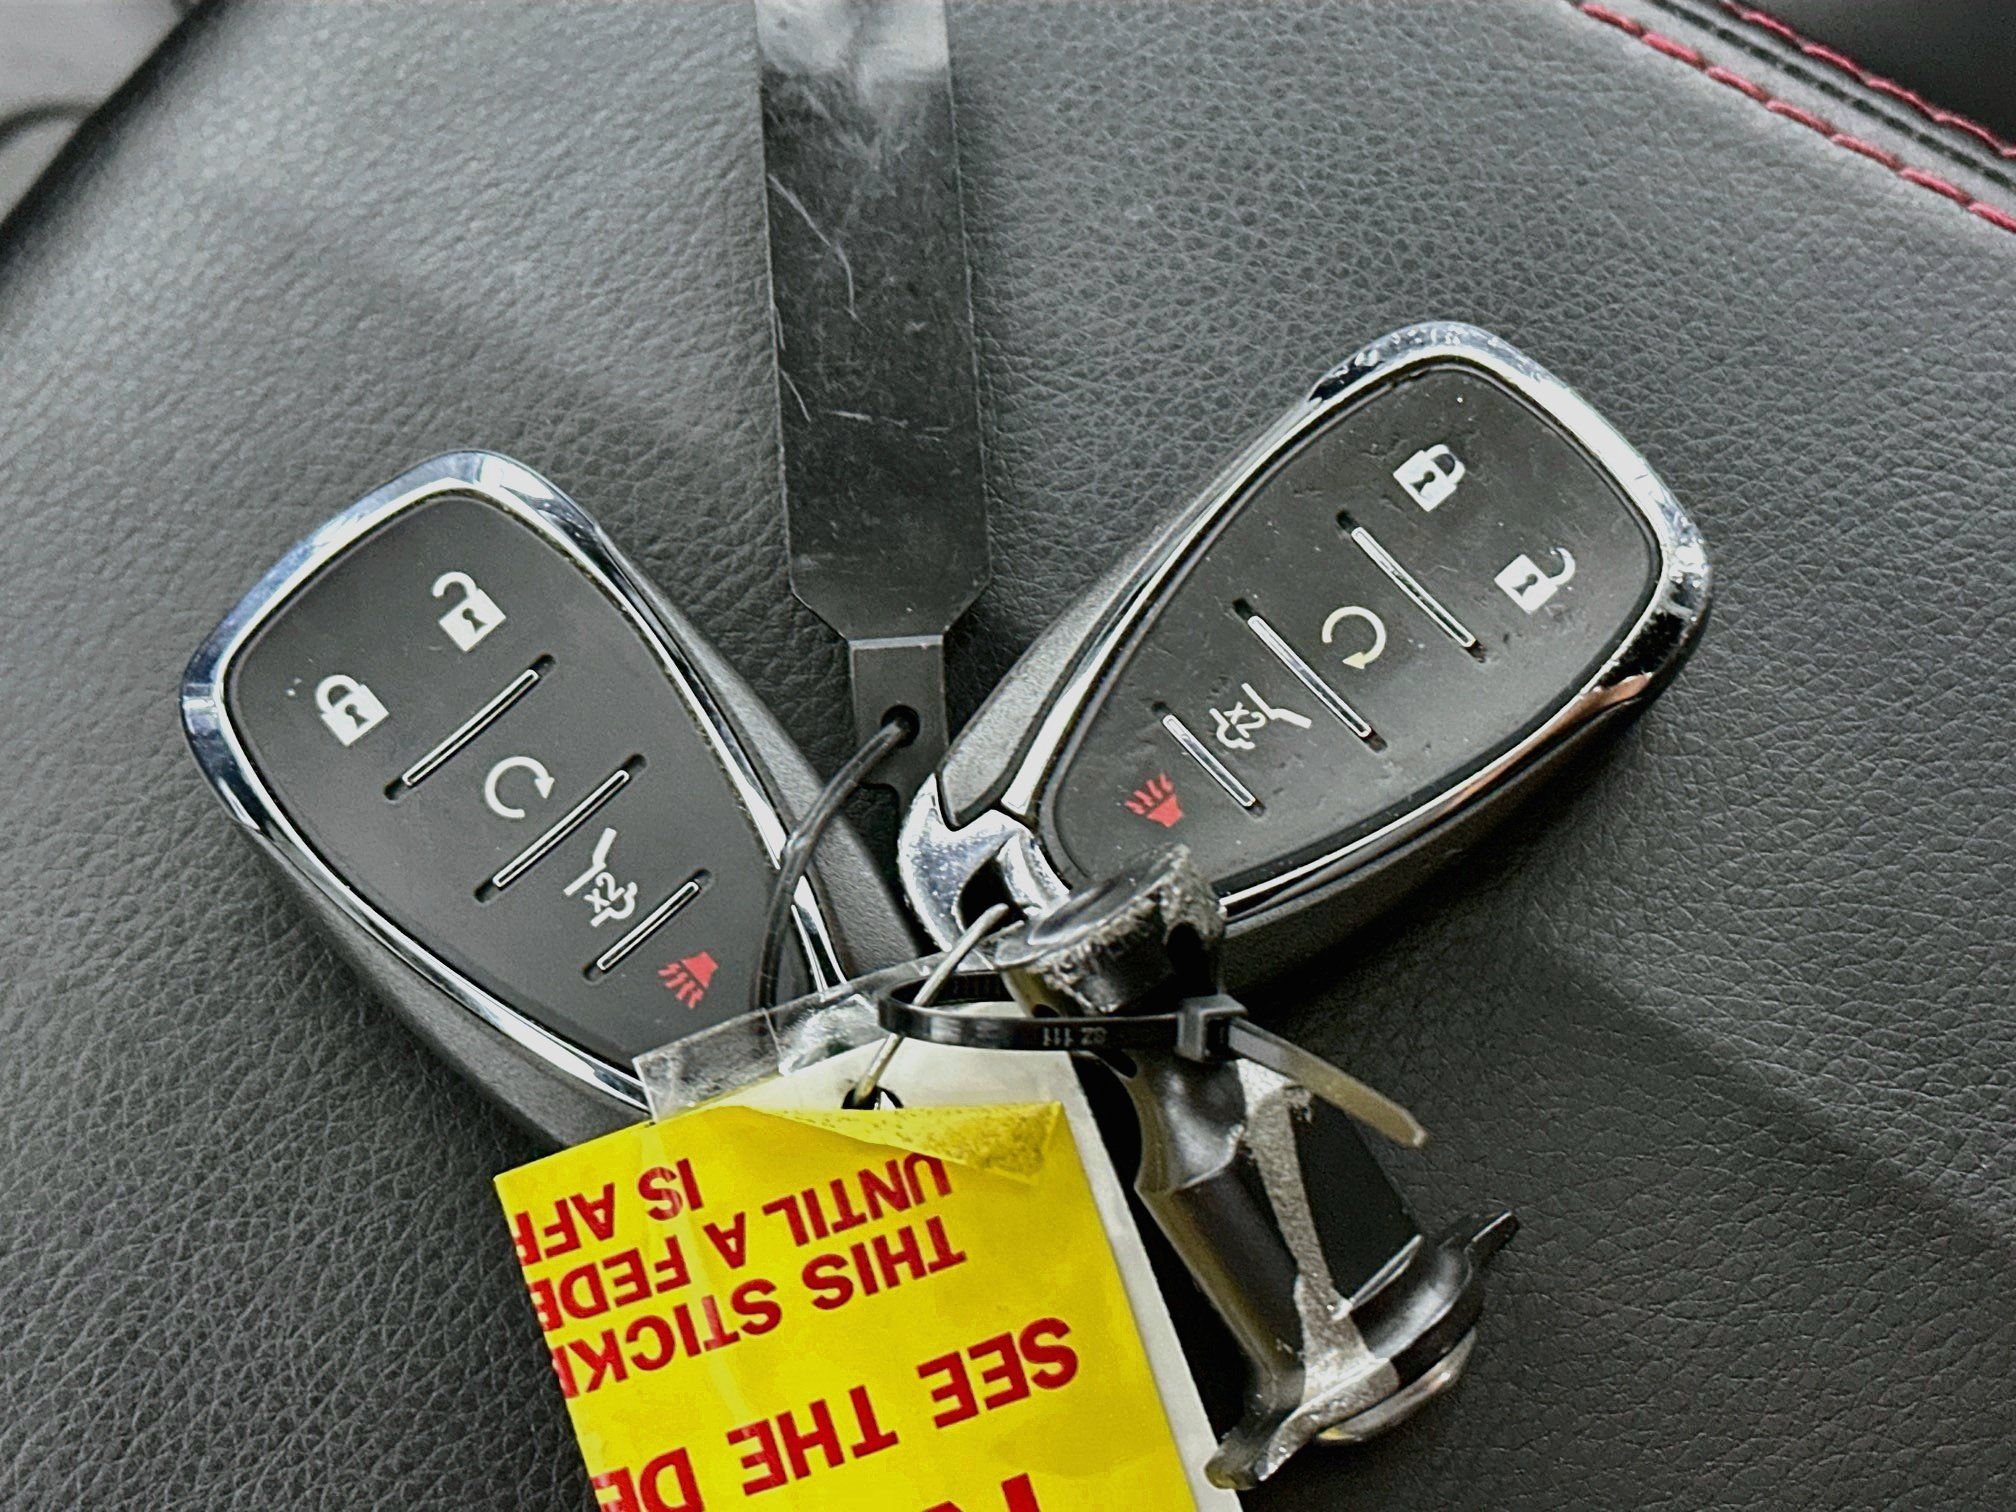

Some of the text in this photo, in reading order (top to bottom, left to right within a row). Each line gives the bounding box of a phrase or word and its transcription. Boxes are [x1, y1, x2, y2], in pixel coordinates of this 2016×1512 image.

[528, 1152, 953, 1333] UNTIL A FEDE
[636, 1157, 704, 1221] IS
[800, 1215, 967, 1311] THIS
[915, 1316, 1079, 1429] SEE
[725, 1384, 900, 1497] THE
